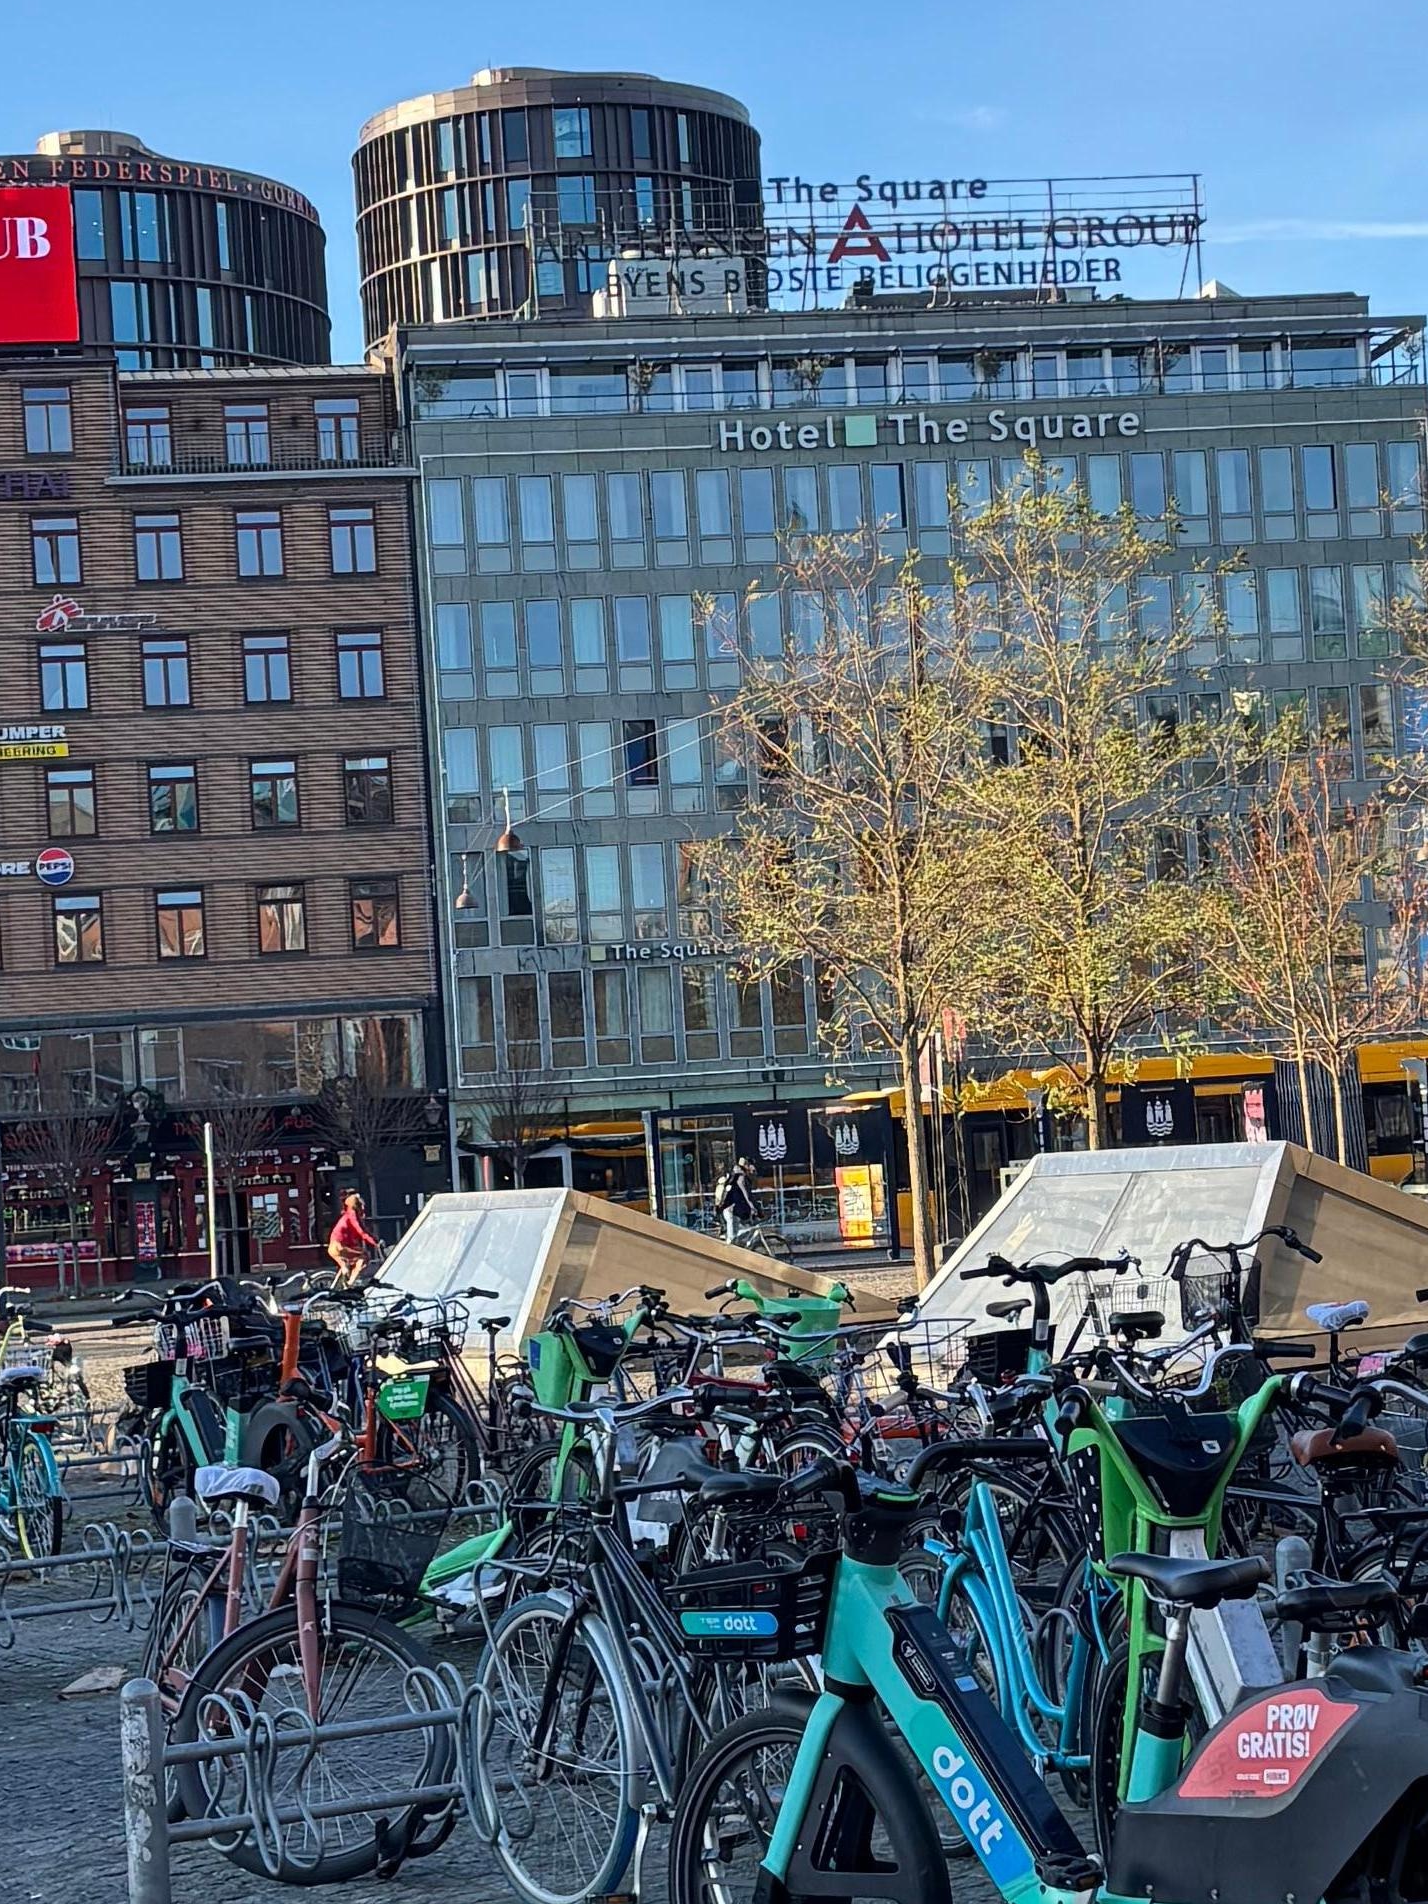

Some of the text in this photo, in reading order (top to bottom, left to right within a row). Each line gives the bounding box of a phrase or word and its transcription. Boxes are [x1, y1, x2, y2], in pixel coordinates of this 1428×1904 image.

[49, 159, 239, 192] FEDERSPIEL
[768, 174, 988, 209] The Square
[894, 218, 1036, 254] HOTEL
[1049, 212, 1201, 249] GROUP
[722, 265, 842, 294] BDSTE
[718, 409, 1140, 452] Hotel The Square
[612, 942, 734, 961] The Square
[723, 1615, 758, 1631] dott
[1266, 1703, 1320, 1731] PRØV
[1237, 1731, 1310, 1759] GRATIS!
[932, 1745, 1004, 1856] dott
